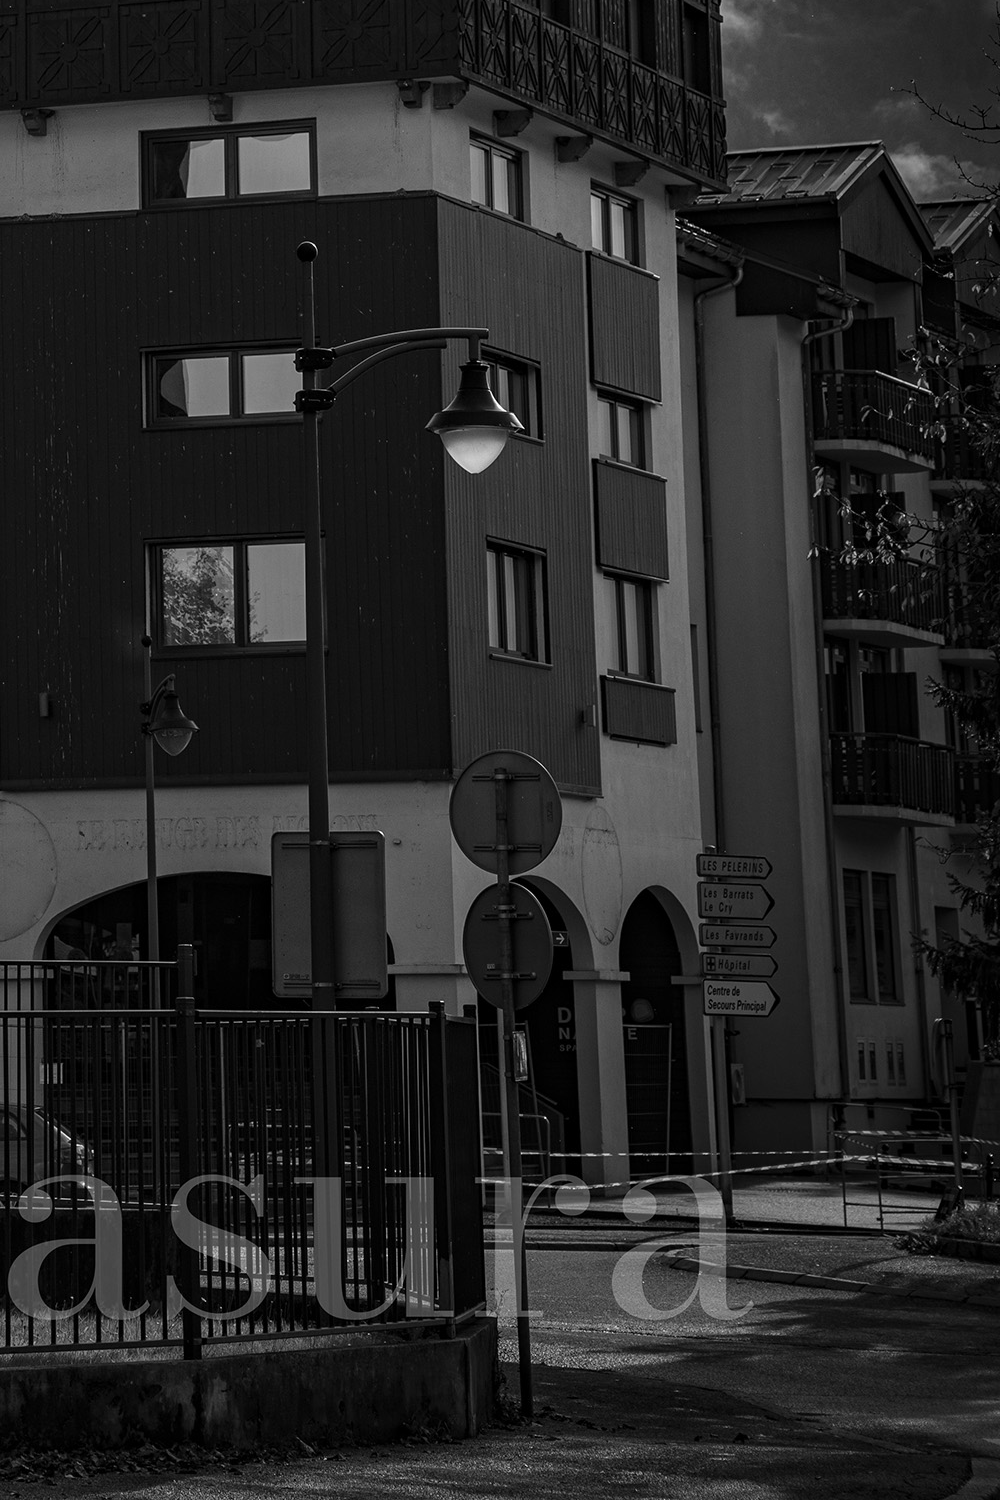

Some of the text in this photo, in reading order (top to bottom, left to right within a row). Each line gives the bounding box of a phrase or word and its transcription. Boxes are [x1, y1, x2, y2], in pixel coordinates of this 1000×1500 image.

[702, 861, 764, 874] LES PELERINS
[704, 888, 754, 901] Les Barrats
[704, 901, 733, 915] Le Cry
[705, 929, 764, 942] Les Favrands
[718, 958, 751, 973] Hôpital
[707, 984, 741, 997] Centre de
[707, 998, 767, 1014] Secours Principal
